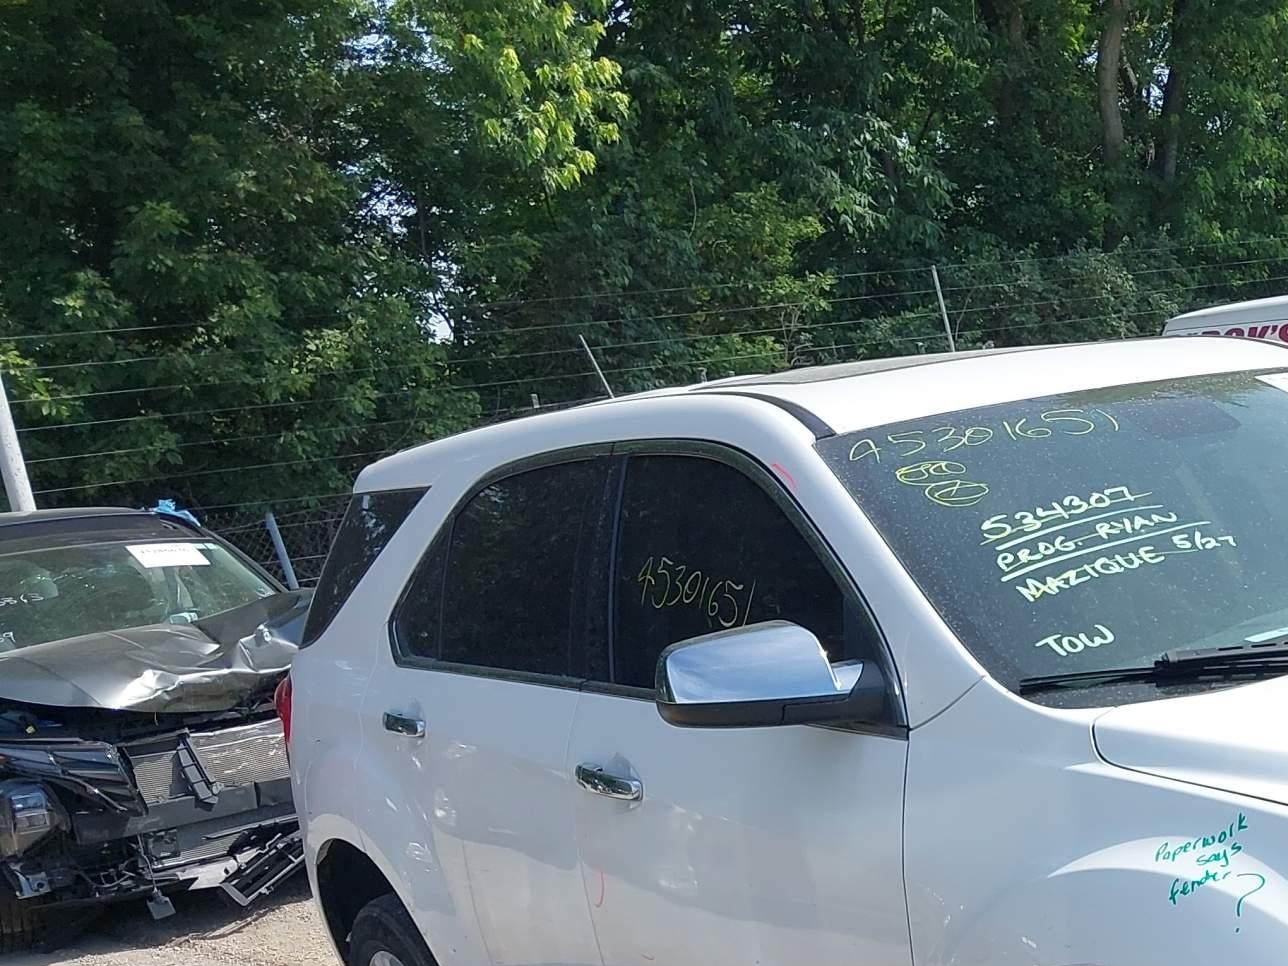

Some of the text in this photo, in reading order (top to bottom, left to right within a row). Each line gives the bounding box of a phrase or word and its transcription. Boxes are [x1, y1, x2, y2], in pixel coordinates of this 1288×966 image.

[980, 486, 1153, 545] 534307
[1095, 511, 1178, 540] RYAN
[1015, 530, 1238, 602] MAZIQUE 5/27
[637, 556, 757, 628] 45301651
[1034, 624, 1116, 657] TOW
[1155, 812, 1249, 862] Paperwork
[1196, 842, 1242, 867] says
